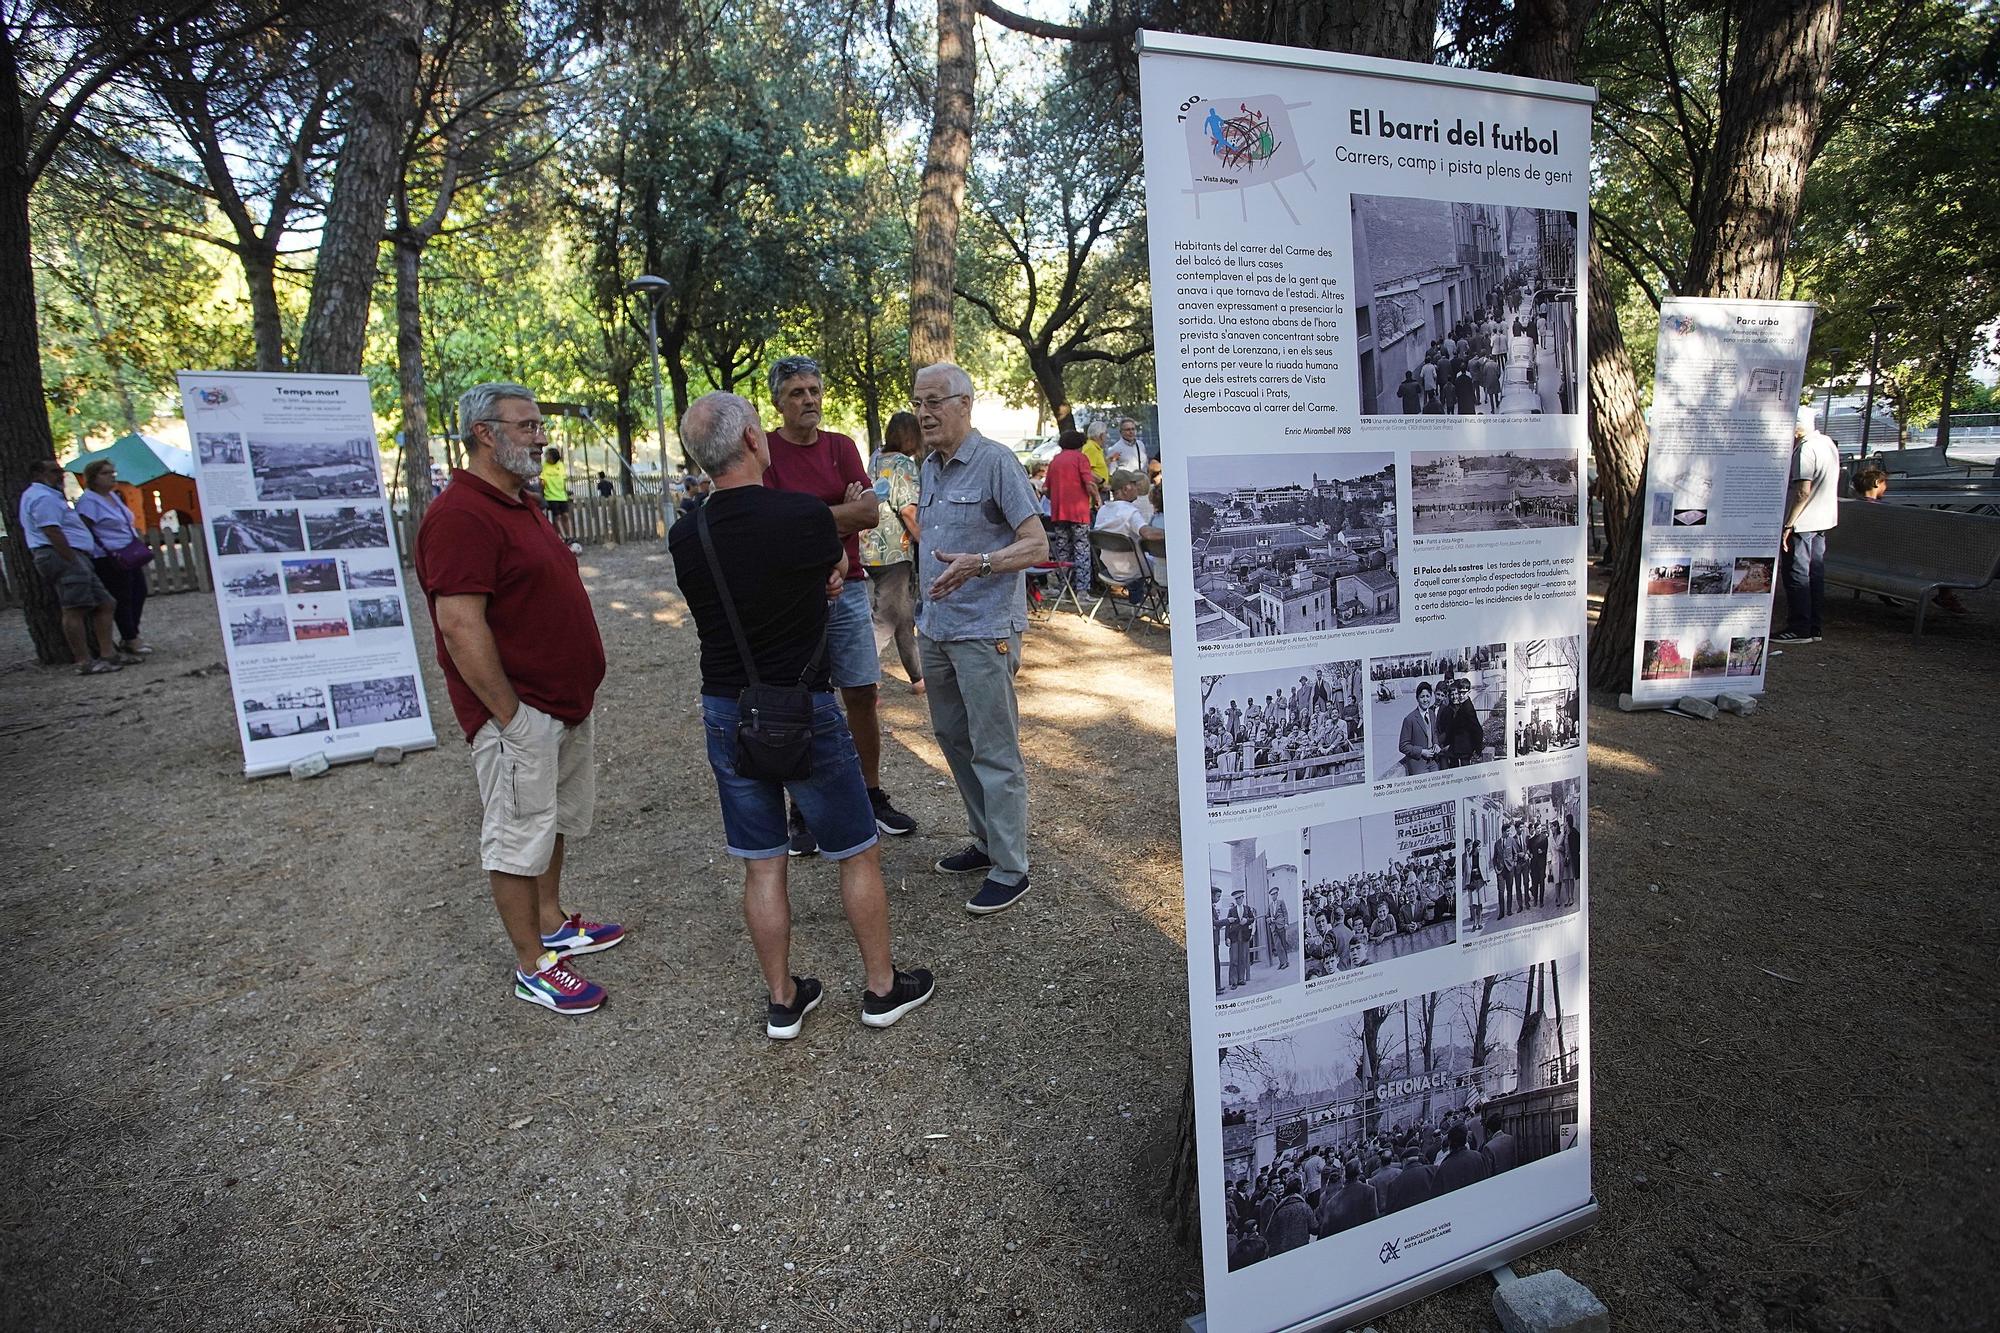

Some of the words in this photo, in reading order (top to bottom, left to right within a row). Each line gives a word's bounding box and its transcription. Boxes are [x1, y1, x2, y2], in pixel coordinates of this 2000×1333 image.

[1178, 96, 1200, 123] 100
[1350, 109, 1370, 135] El
[1379, 110, 1439, 142] barri
[1447, 119, 1484, 147] del
[1492, 123, 1558, 155] futbol
[1336, 146, 1393, 168] Carrers,
[1398, 156, 1436, 174] camp
[1440, 159, 1443, 171] i
[1449, 160, 1482, 176] pista
[1487, 163, 1520, 179] plens
[1524, 164, 1540, 179] de
[1545, 170, 1572, 185] gent
[1175, 241, 1221, 251] Habitants
[1224, 242, 1237, 252] del
[1241, 245, 1267, 253] carrer
[1270, 244, 1283, 254] del
[1286, 246, 1315, 256] Carme
[1318, 248, 1332, 257] des
[1176, 255, 1190, 265] del
[1194, 256, 1221, 265] balcó
[1224, 256, 1235, 266] de
[1238, 257, 1256, 267] llurs
[1258, 260, 1283, 268] cases
[1177, 271, 1243, 282] contemplaven
[1246, 272, 1254, 282] el
[1257, 275, 1272, 284] pas
[1275, 273, 1286, 283] de
[1289, 274, 1296, 283] la
[1300, 276, 1318, 286] gent
[1321, 278, 1336, 287] que
[1216, 288, 1233, 298] que
[1236, 288, 1269, 297] tornava
[1273, 288, 1283, 297] de
[1286, 289, 1319, 298] l'estadi.
[1321, 290, 1344, 300] Altres
[1178, 302, 1214, 310] anaven
[1217, 303, 1278, 314] expressament
[1290, 305, 1333, 314] presenciar
[1335, 305, 1342, 313] la
[1179, 315, 1216, 325] sortida.
[1219, 316, 1236, 325] Una
[1272, 317, 1298, 326] abans
[1301, 317, 1311, 326] de
[1314, 318, 1336, 327] l'hora
[1180, 330, 1218, 342] prevista
[1221, 329, 1260, 340] s'anaven
[1263, 332, 1314, 341] concentrant
[1317, 332, 1339, 342] sobre
[1181, 345, 1189, 354] el
[1193, 346, 1215, 356] pont
[1218, 345, 1229, 354] de
[1233, 345, 1280, 356] Lorenzana,
[1283, 346, 1285, 354] i
[1301, 346, 1312, 355] els
[1315, 348, 1332, 356] seus
[1182, 360, 1218, 369] entorns
[1221, 361, 1236, 370] per
[1265, 359, 1273, 368] la
[1276, 360, 1303, 369] riuada
[1306, 360, 1338, 369] humana
[1183, 376, 1201, 385] que
[1205, 374, 1224, 383] dels
[1227, 375, 1257, 383] estrets
[1291, 374, 1302, 383] de
[1305, 375, 1326, 383] Vista
[276, 387, 312, 396] Temps
[1183, 389, 1215, 400] Alegre
[1219, 389, 1221, 397] i
[1224, 388, 1258, 397] Pascual
[1262, 389, 1264, 397] i
[1267, 388, 1290, 398] Prats,
[1184, 403, 1250, 413] desembocava
[1254, 403, 1261, 412] al
[1264, 404, 1289, 412] carrer
[1292, 403, 1305, 412] del
[1308, 403, 1338, 412] Carme.
[1422, 566, 1441, 574] Palco
[1487, 562, 1497, 570] Les
[1500, 560, 1521, 568] tardes
[1522, 559, 1531, 567] de
[1533, 558, 1551, 568] partit,
[1561, 556, 1574, 566] espai
[1414, 578, 1440, 587] d'aquell
[1442, 577, 1460, 585] carrer
[1462, 575, 1487, 585] s'omplia
[1489, 570, 1535, 581] d'espectadors
[1537, 569, 1569, 577] fraudulents,
[1414, 592, 1427, 600] que
[1449, 589, 1466, 599] pagar
[1469, 585, 1493, 593] entrada
[1496, 582, 1518, 593] podien
[1520, 582, 1540, 592] seguir
[1567, 579, 1576, 587] que
[1421, 602, 1438, 610] certa
[1475, 596, 1484, 605] les
[1486, 594, 1522, 604] incidències
[1524, 593, 1532, 601] de
[1542, 589, 1576, 598] confrontació
[1415, 613, 1446, 623] esportiva.
[1258, 805, 1277, 813] graderia
[1412, 809, 1441, 821] ESTRELLAS
[1398, 823, 1441, 838] RADIANT
[1377, 1077, 1431, 1100] GERONA
[1404, 1229, 1430, 1243] ASSOCIACIÓ
